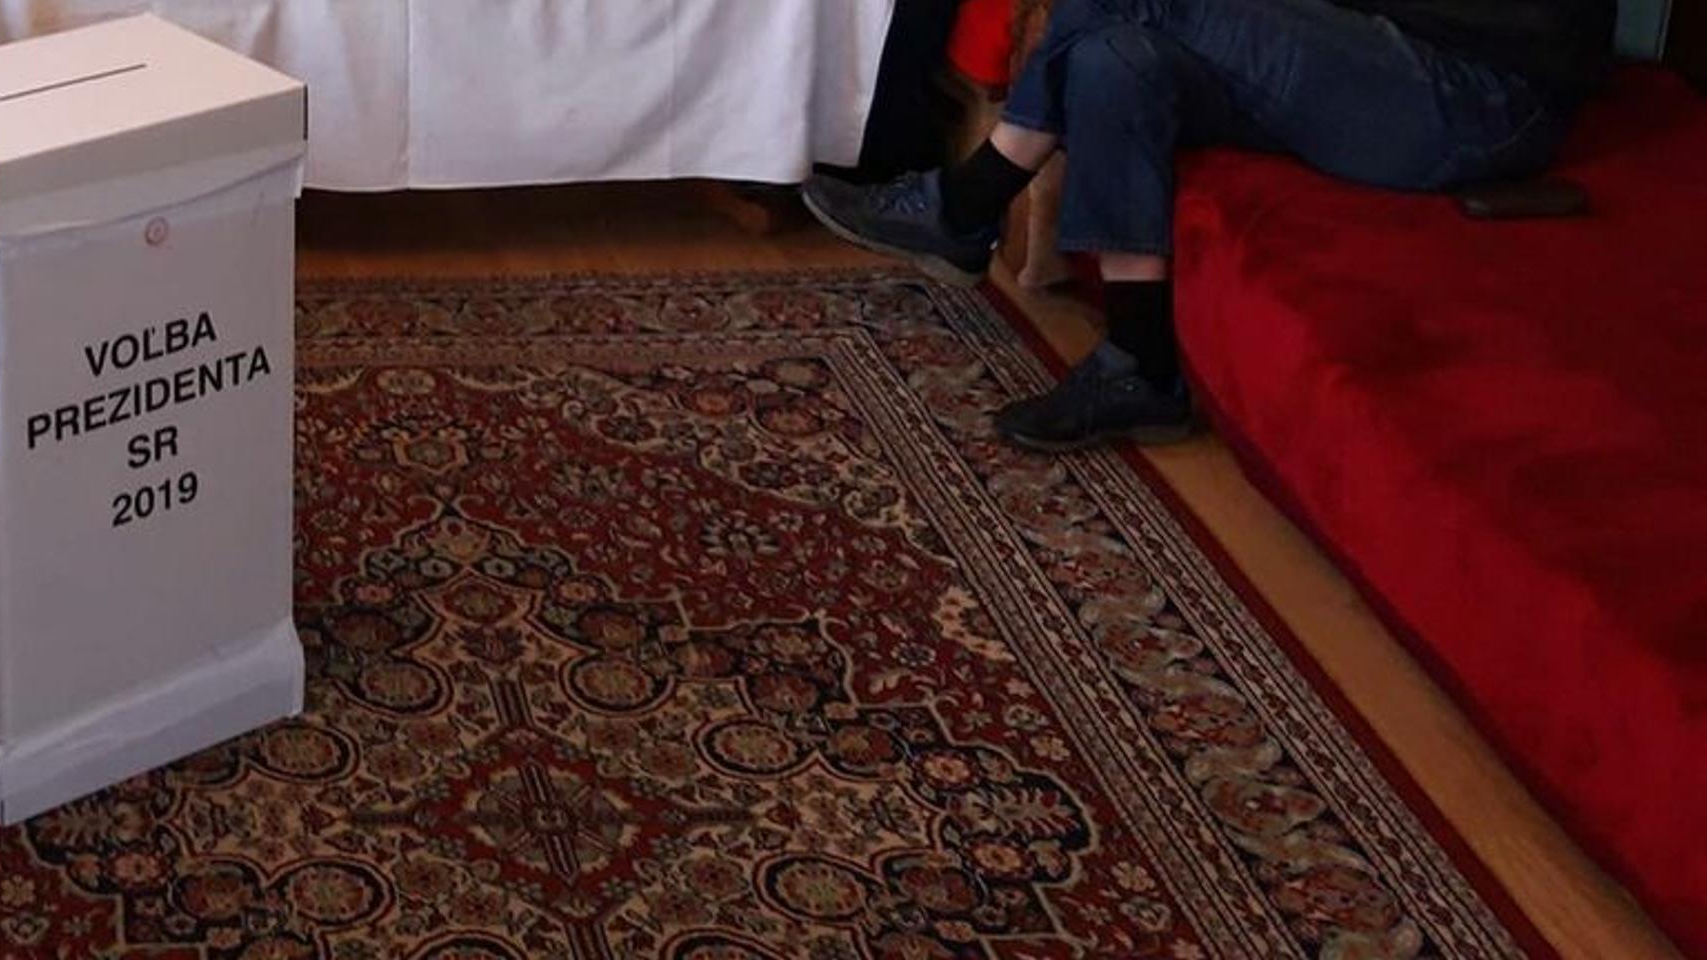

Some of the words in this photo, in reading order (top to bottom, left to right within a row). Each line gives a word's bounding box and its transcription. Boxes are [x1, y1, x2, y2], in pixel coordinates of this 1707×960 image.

[84, 311, 217, 377] VOĽBA
[27, 346, 271, 450] PREZIDENTA
[127, 426, 178, 469] SR
[111, 471, 199, 527] 2019
